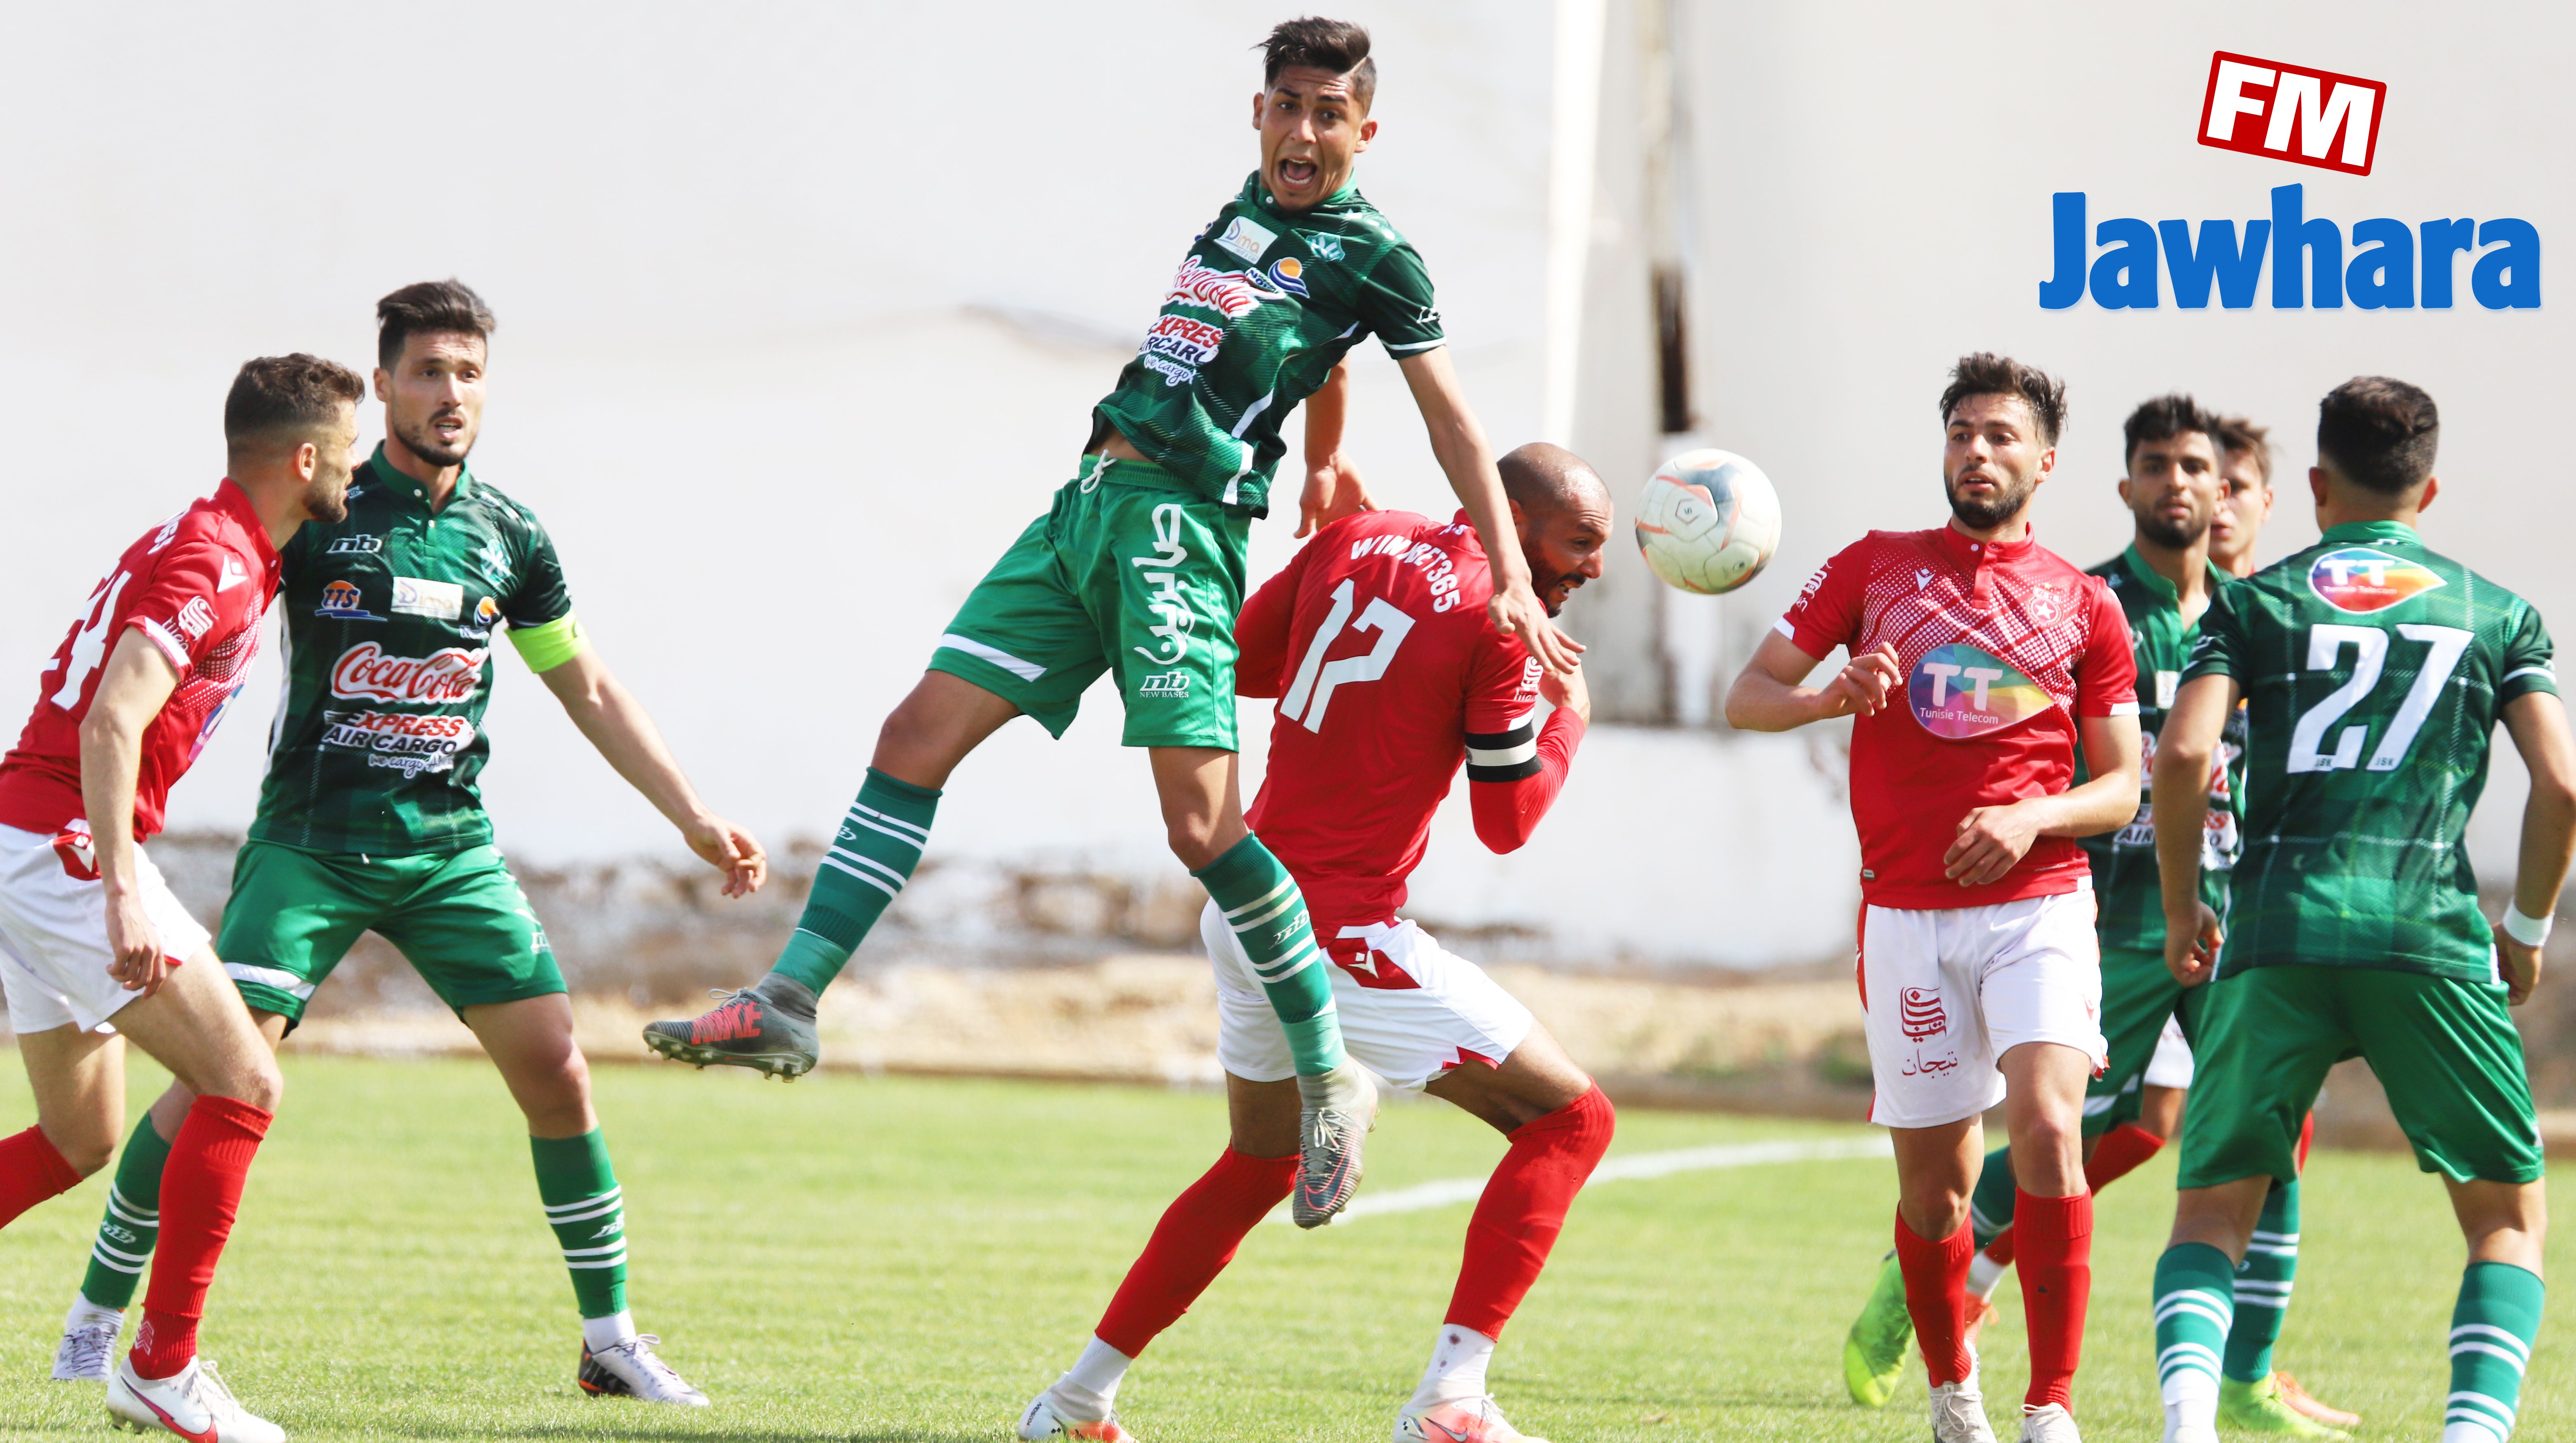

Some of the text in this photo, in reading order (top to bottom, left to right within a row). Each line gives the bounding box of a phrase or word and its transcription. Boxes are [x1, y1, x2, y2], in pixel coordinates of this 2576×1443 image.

[1225, 218, 1260, 253] Dima
[1158, 362, 1189, 384] cargo
[2319, 559, 2395, 586] TT
[333, 645, 480, 699] Coca-Cola
[1923, 662, 2003, 711] TT
[2287, 624, 2475, 774] 27
[338, 710, 464, 737] EXPRESS
[1920, 707, 1998, 724] Tunisie Telecom
[324, 728, 457, 755] AIR CARGO
[389, 757, 423, 776] cargo
[1902, 1048, 1958, 1079] تيجان
